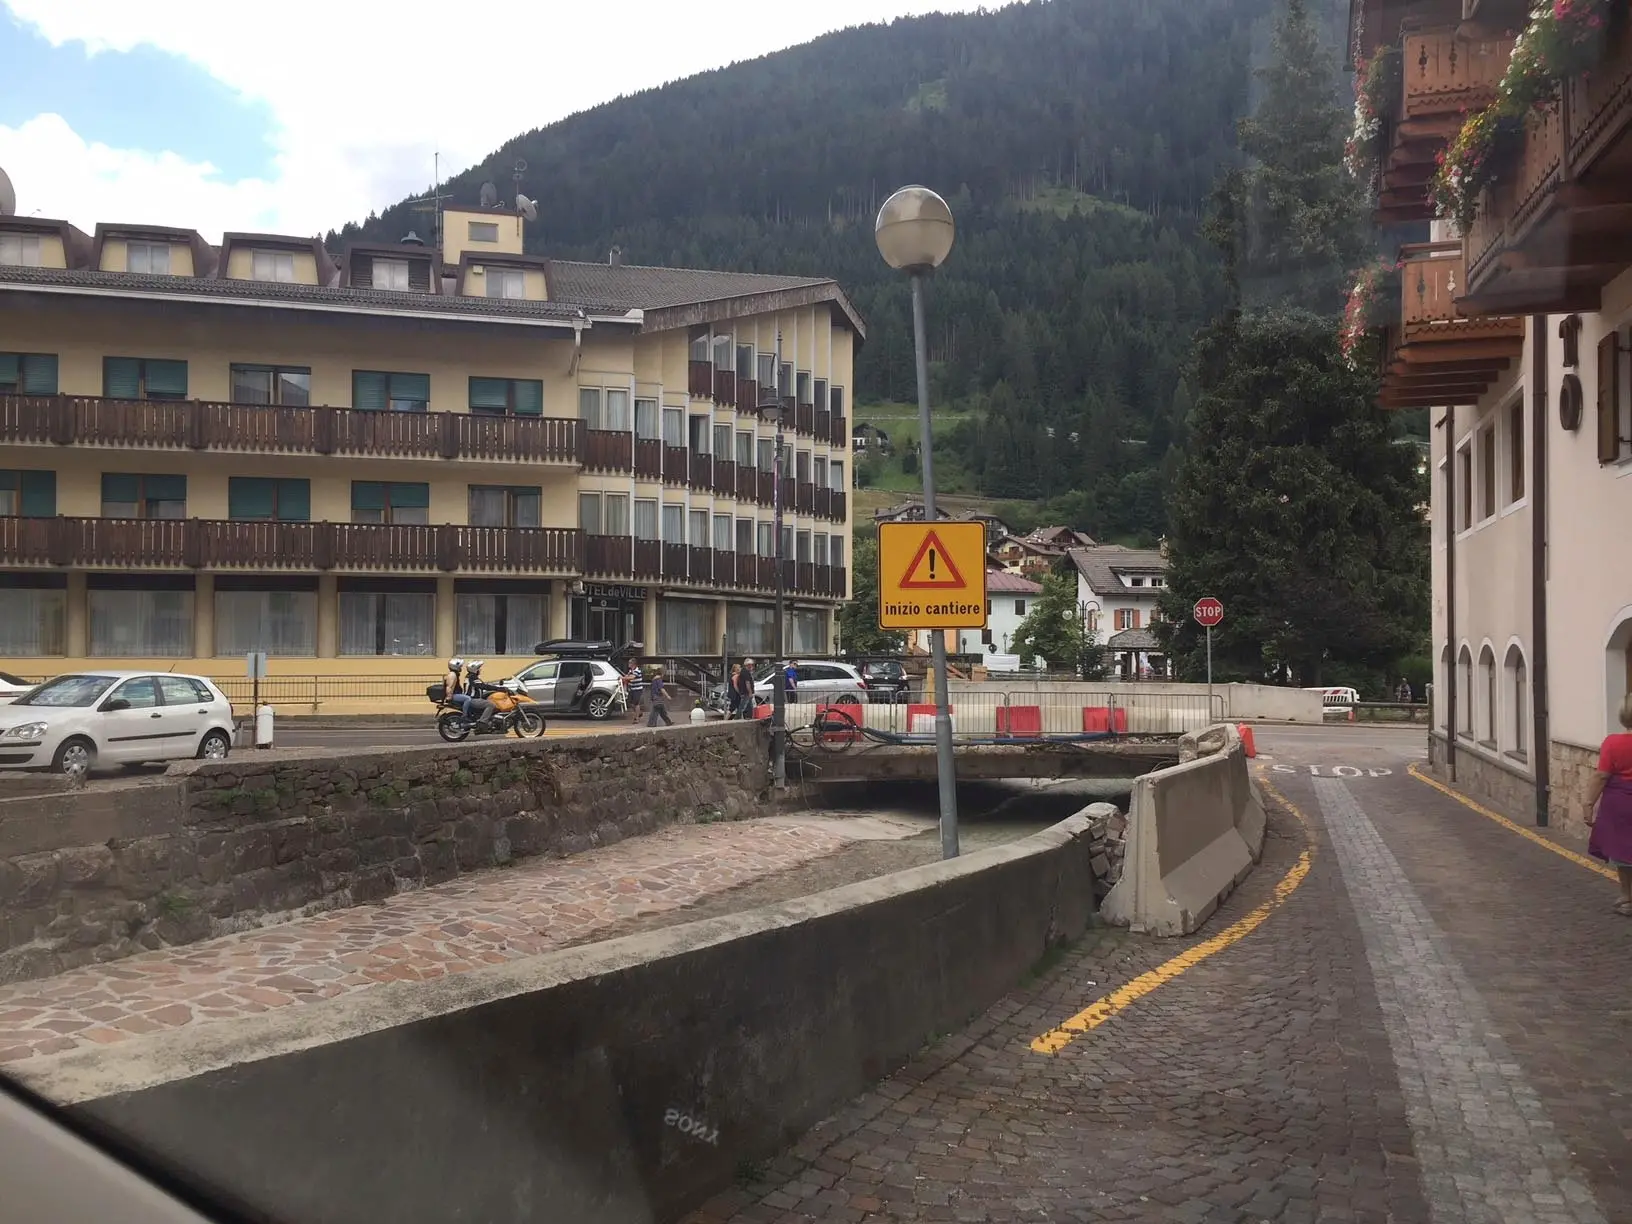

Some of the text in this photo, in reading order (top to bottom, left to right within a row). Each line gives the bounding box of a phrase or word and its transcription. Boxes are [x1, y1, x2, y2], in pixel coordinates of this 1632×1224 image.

[885, 601, 980, 615] inizio cantiere
[1195, 606, 1221, 617] STOP
[1272, 764, 1393, 778] STOP
